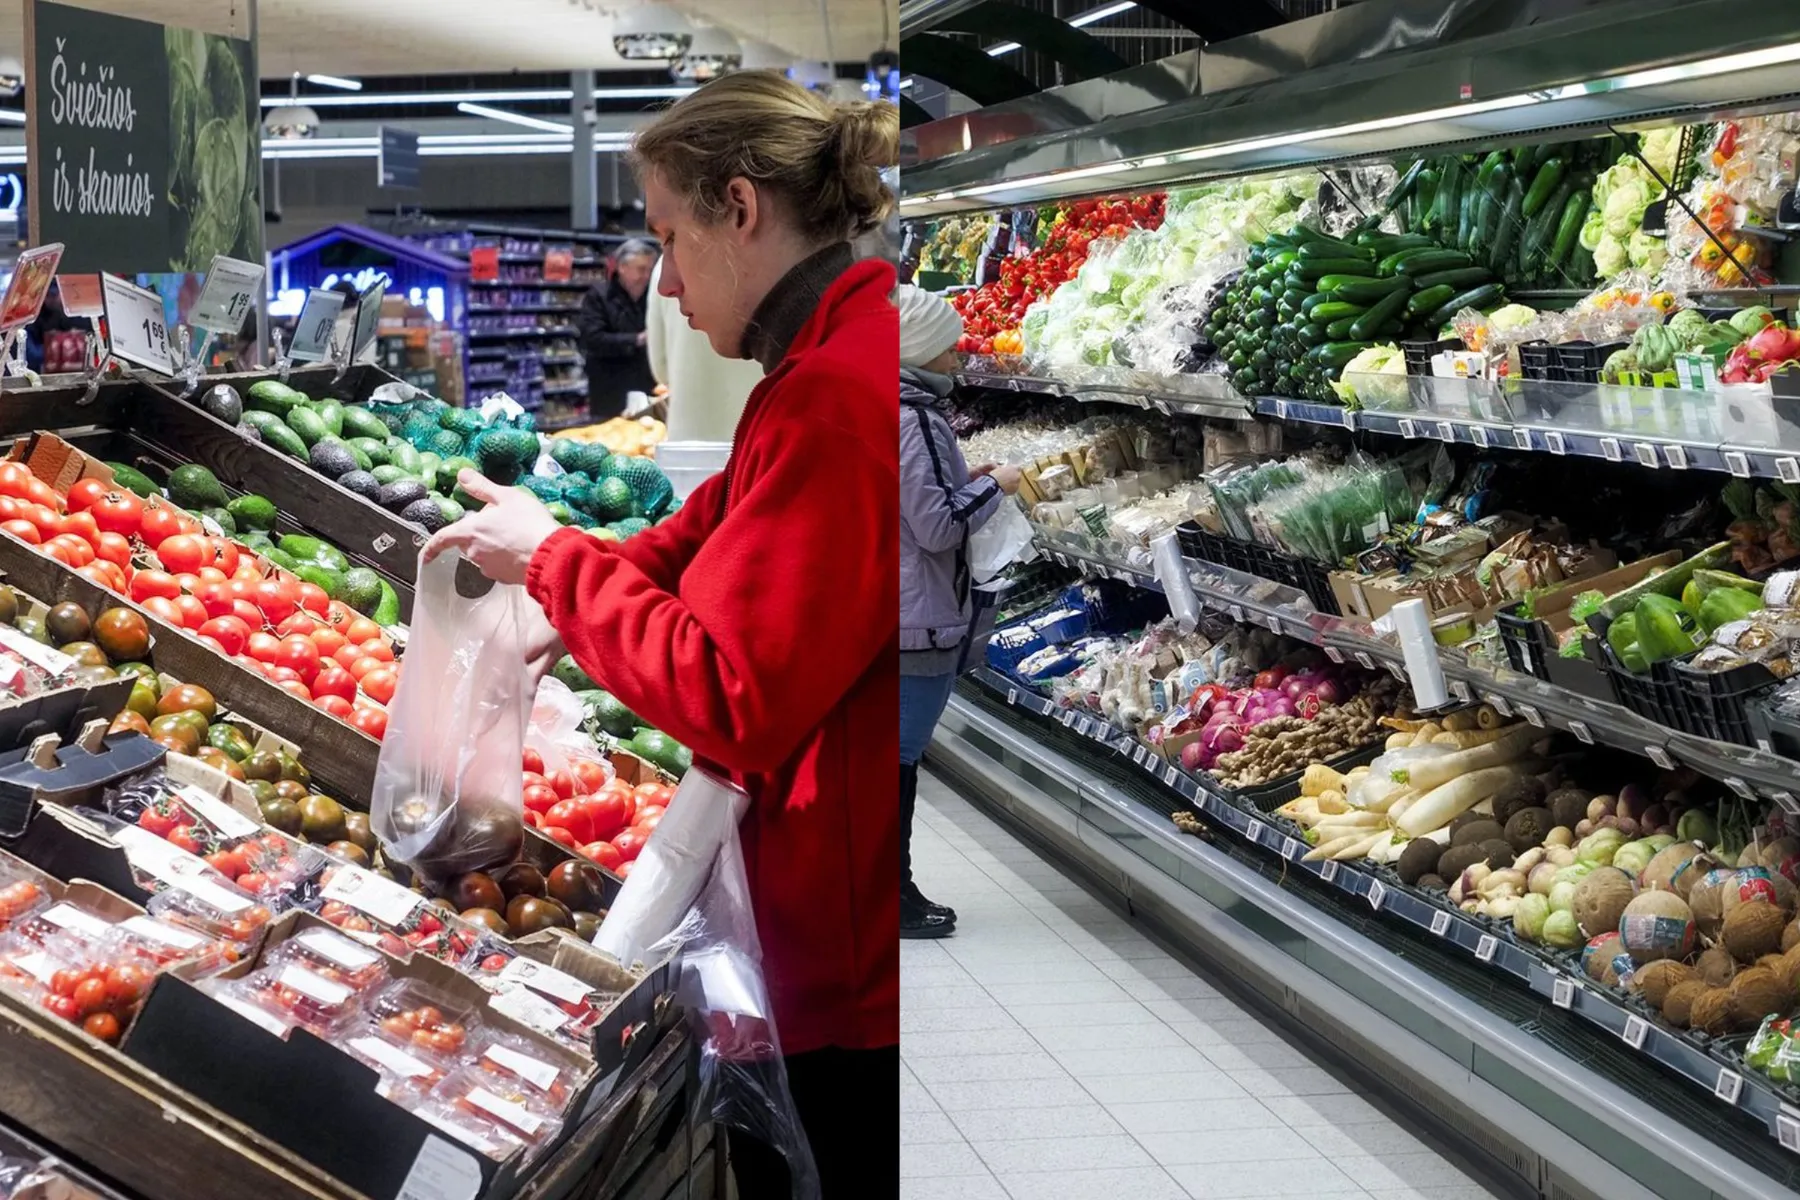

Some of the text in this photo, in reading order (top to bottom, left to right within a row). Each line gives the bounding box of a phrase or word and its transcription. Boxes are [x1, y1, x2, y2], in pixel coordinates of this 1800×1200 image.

[51, 36, 137, 133] Šviežios
[53, 146, 74, 213] ir
[78, 146, 155, 217] skanios
